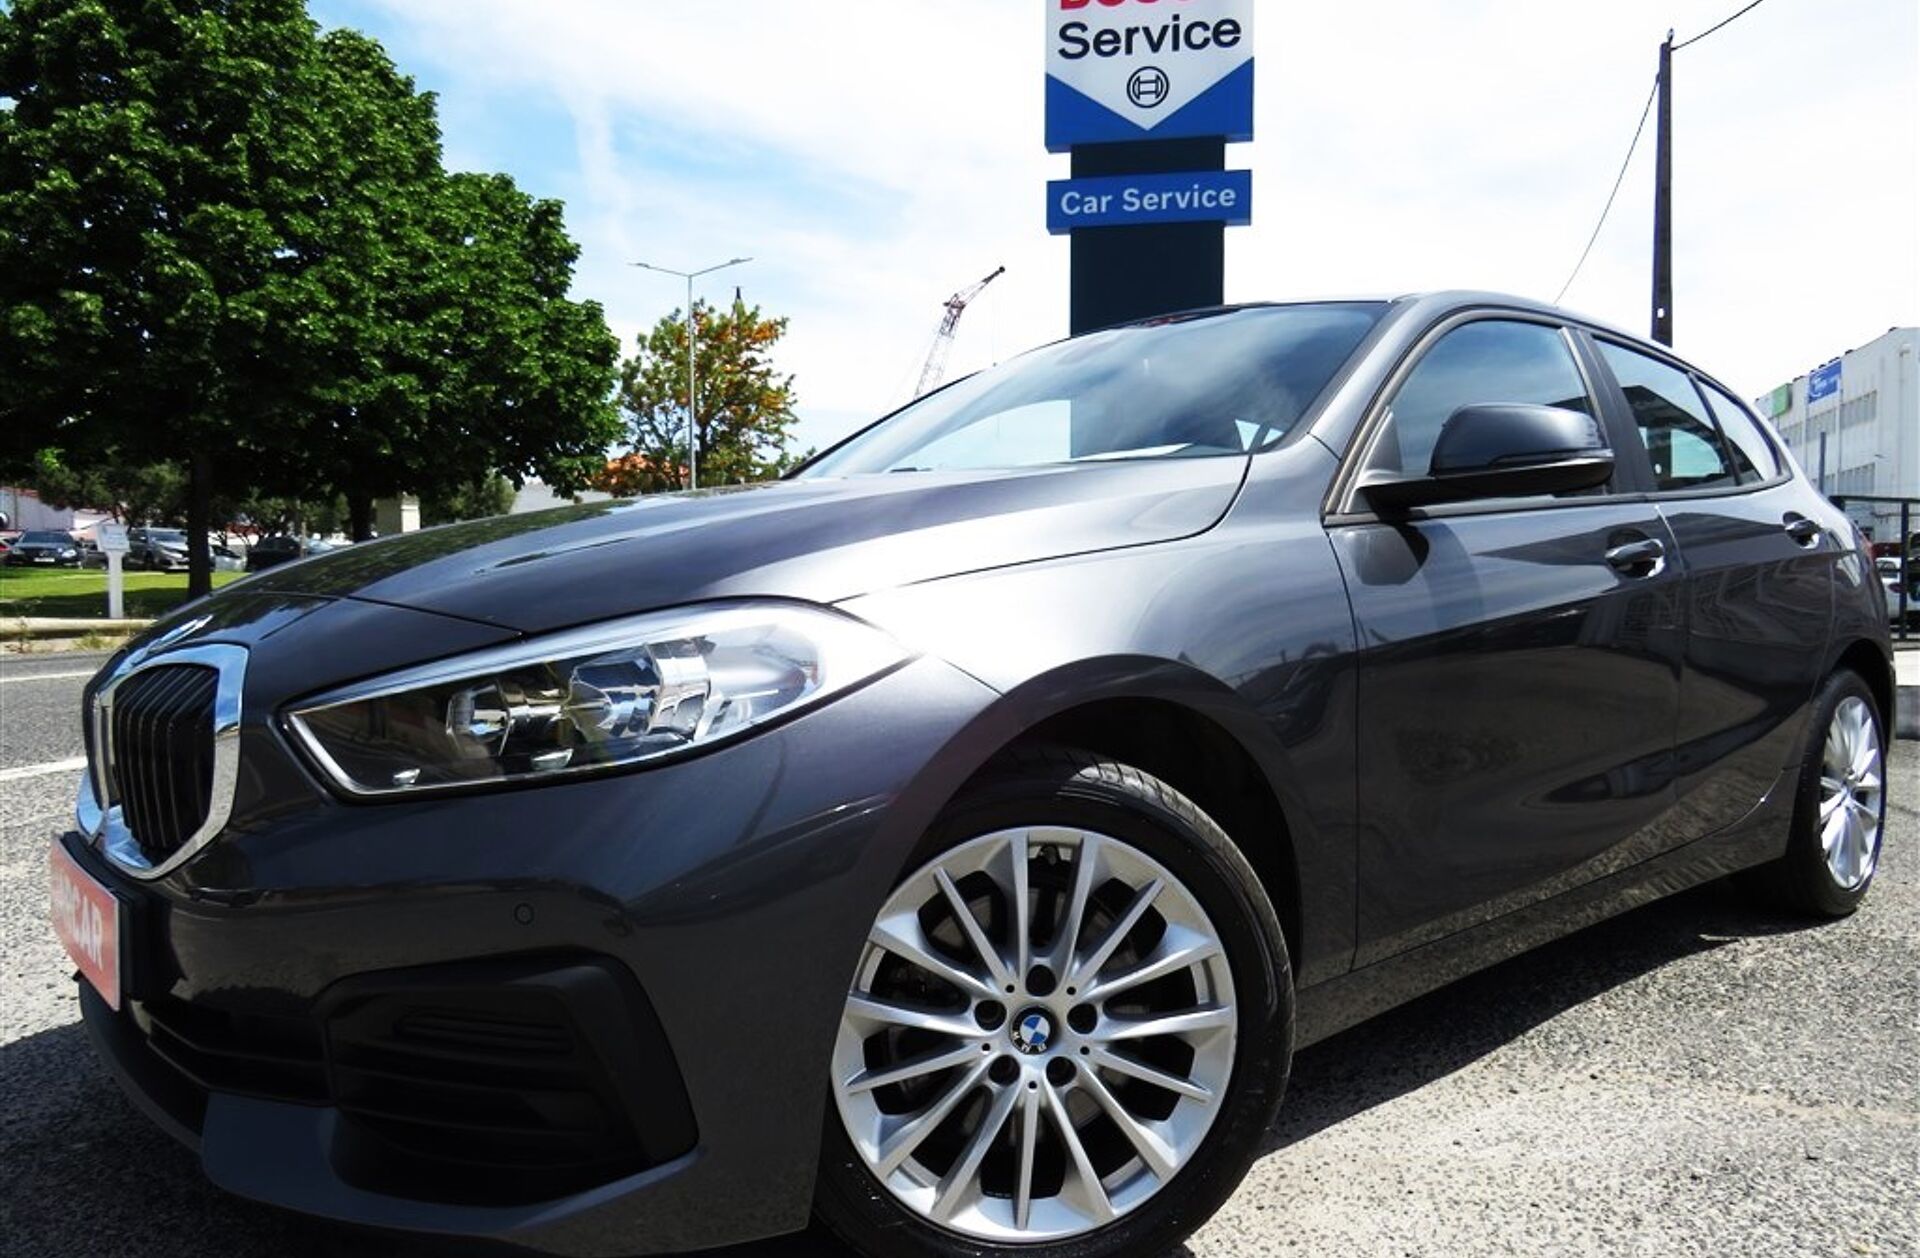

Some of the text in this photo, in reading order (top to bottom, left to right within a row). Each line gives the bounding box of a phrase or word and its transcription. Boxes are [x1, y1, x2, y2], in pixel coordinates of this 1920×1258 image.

[1057, 13, 1242, 60] Service
[1060, 183, 1237, 216] Car Service
